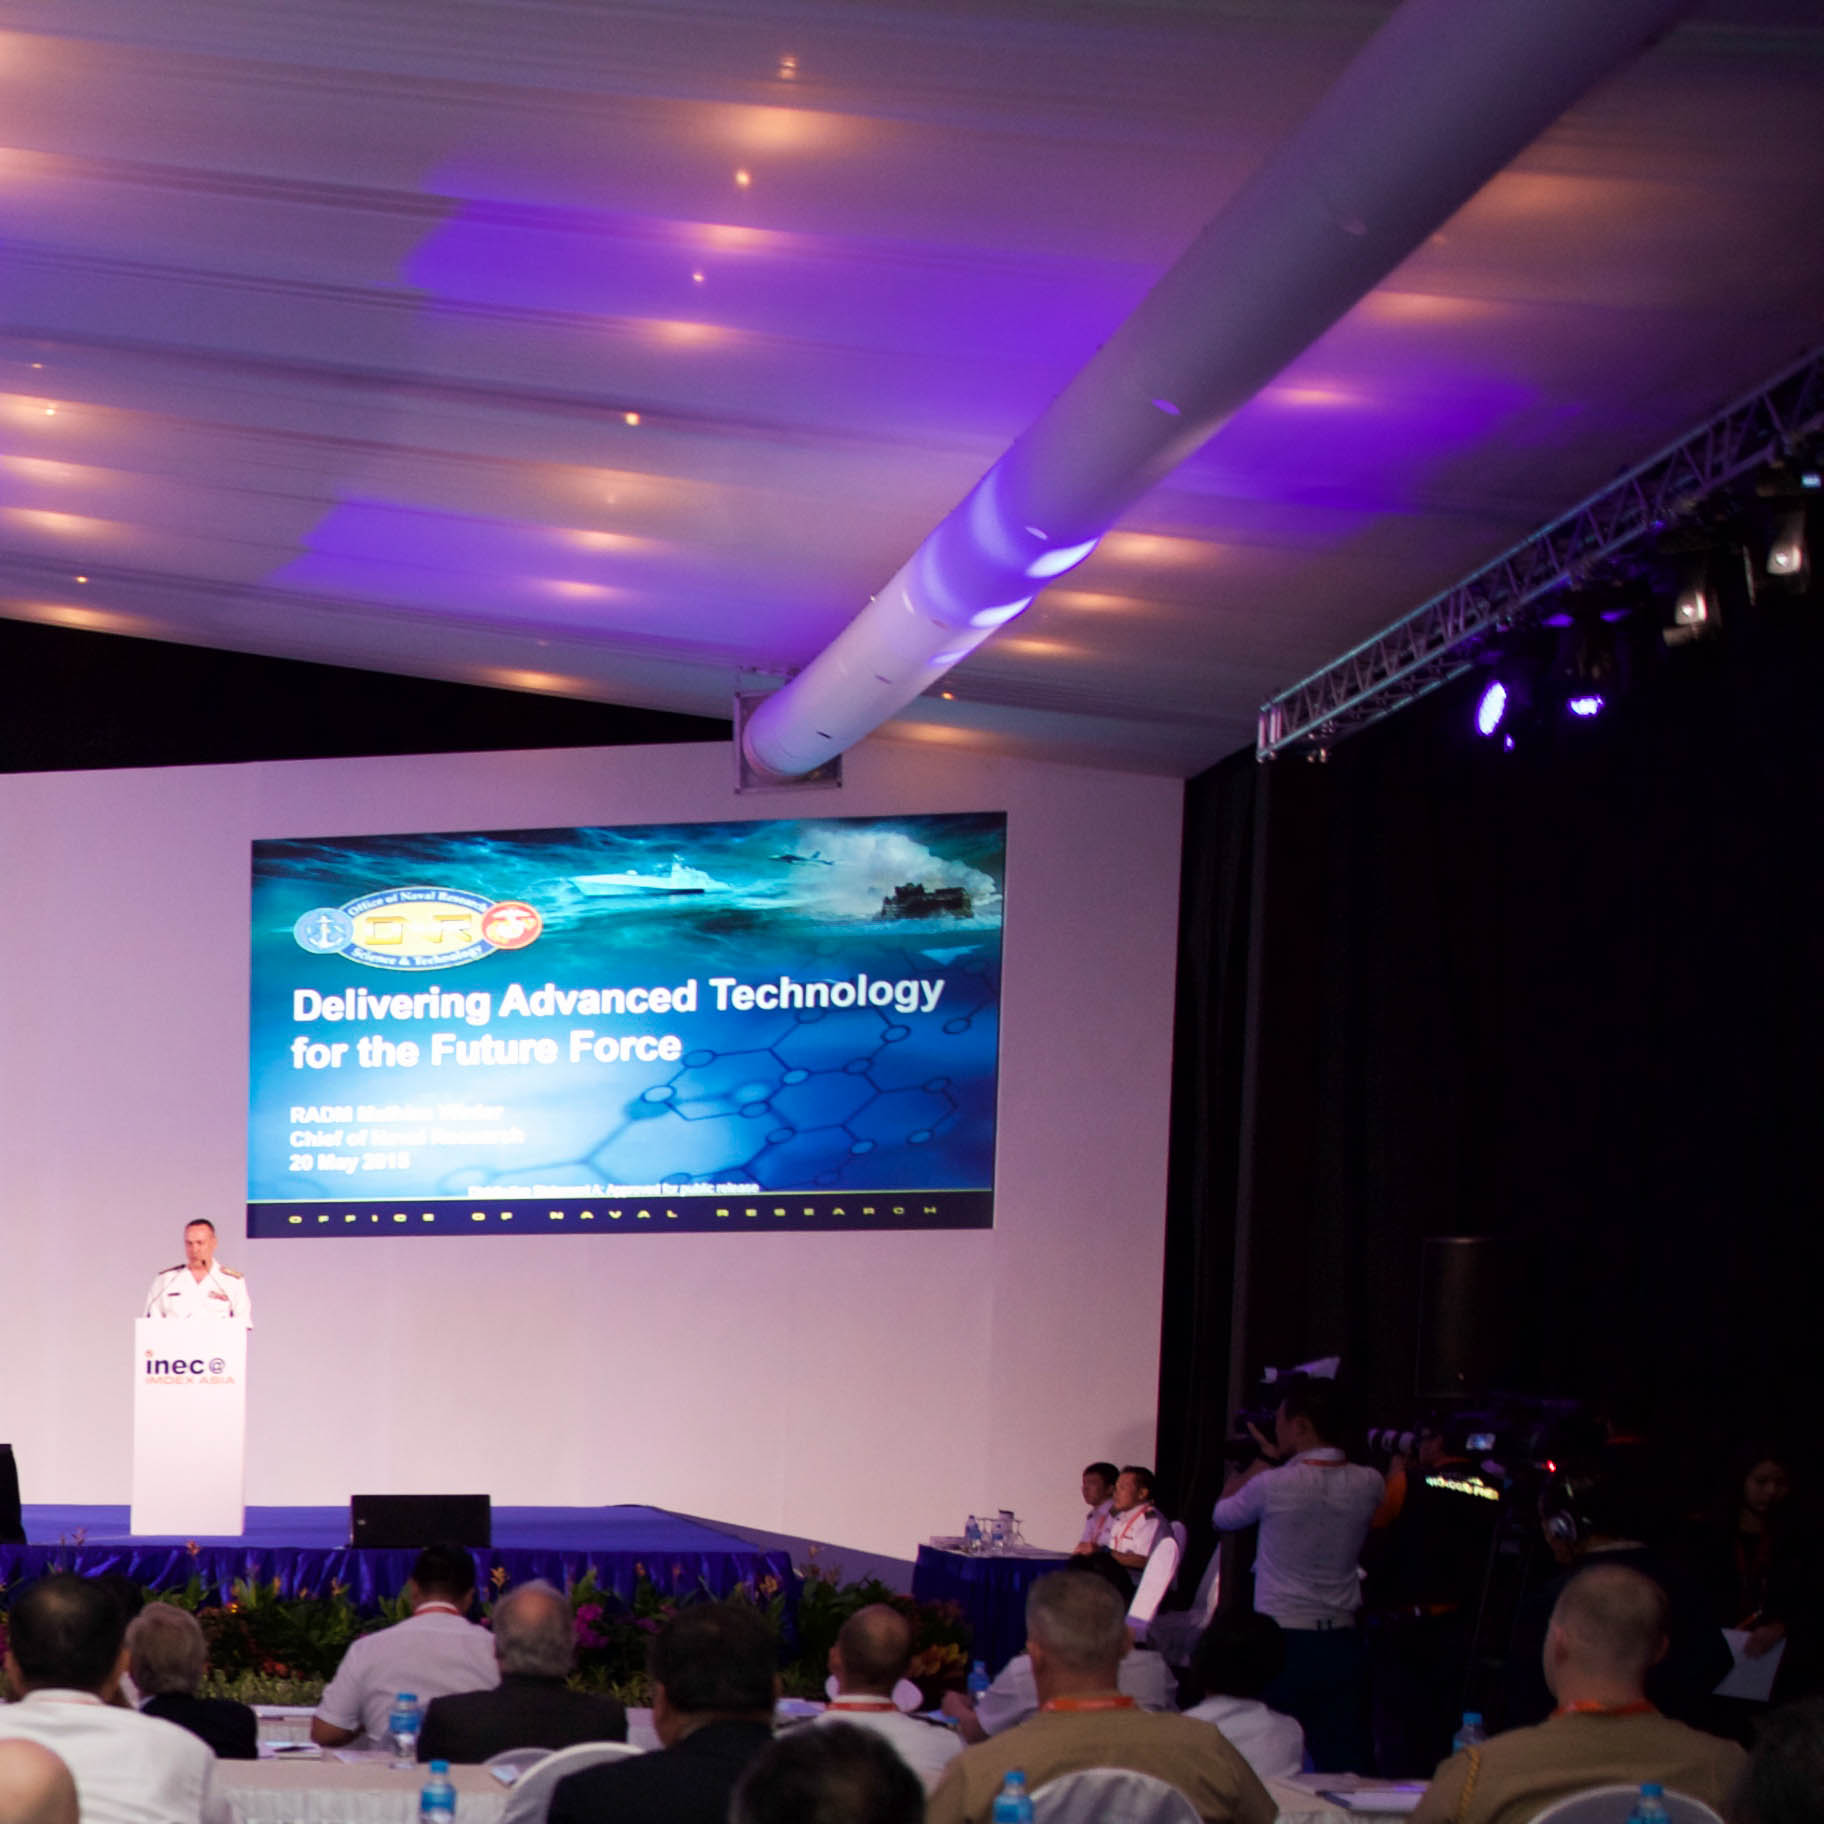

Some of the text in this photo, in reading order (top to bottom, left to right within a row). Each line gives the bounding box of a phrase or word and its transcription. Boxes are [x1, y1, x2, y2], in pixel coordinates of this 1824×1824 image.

[292, 974, 945, 1026] Delivering Advanced Technology
[291, 1029, 682, 1069] for the Future Force
